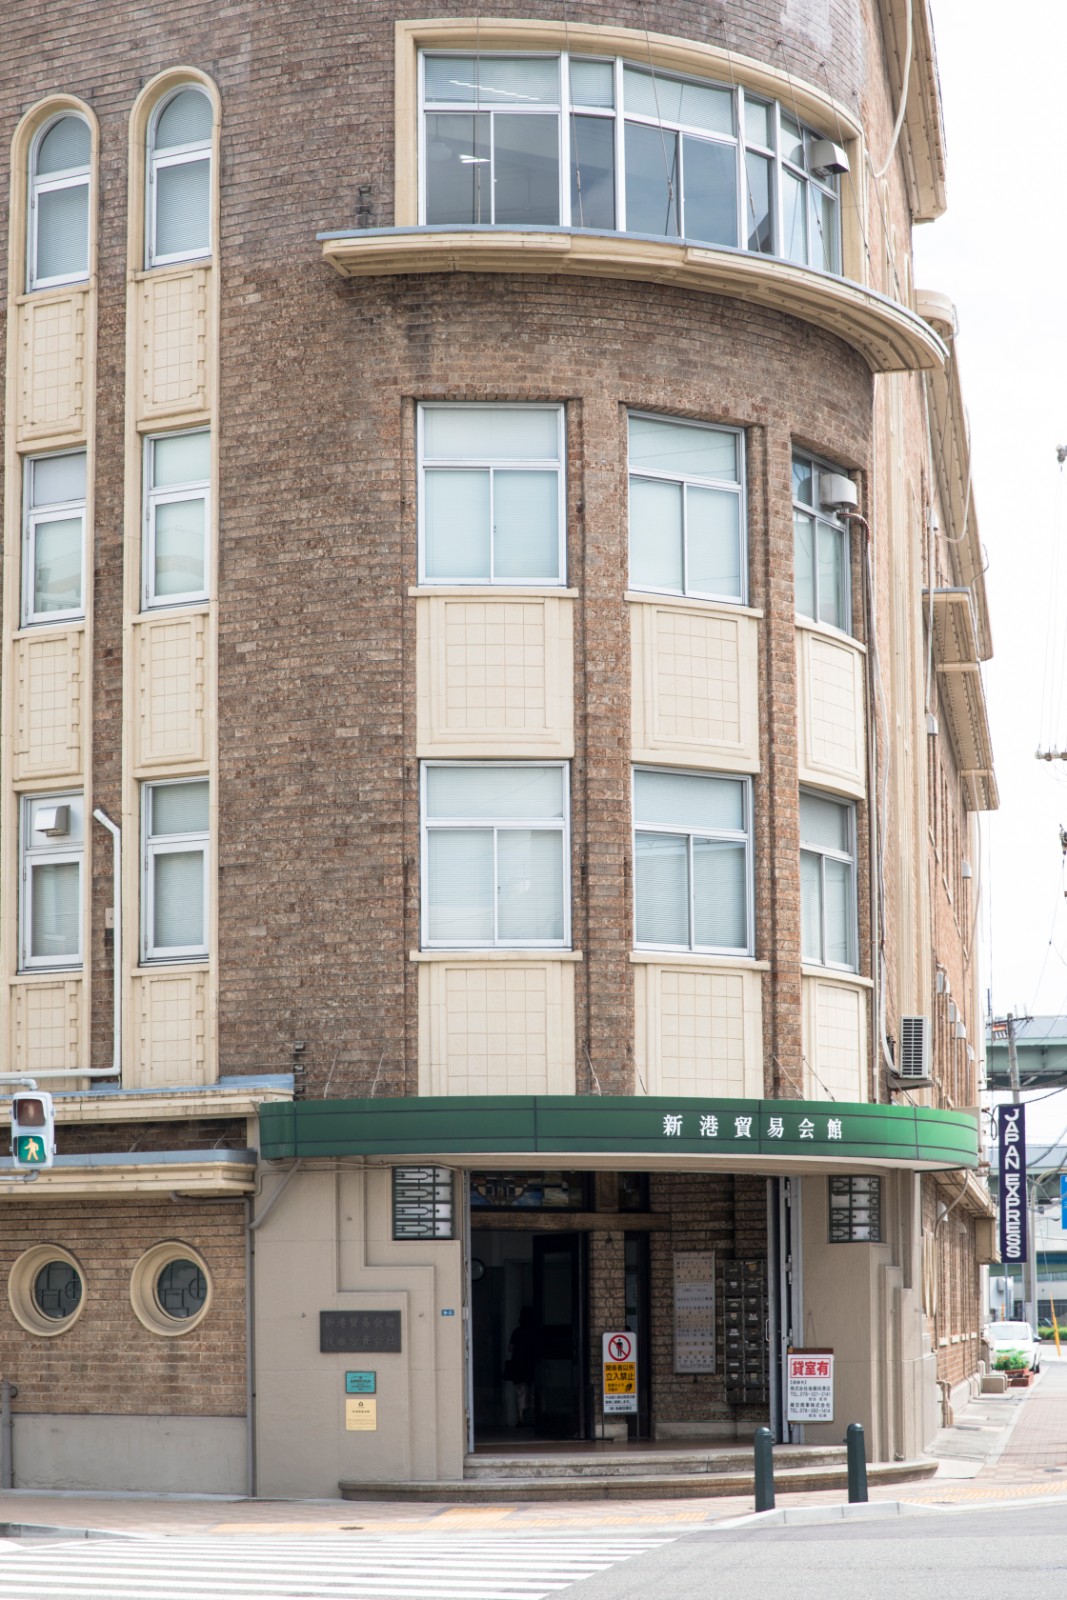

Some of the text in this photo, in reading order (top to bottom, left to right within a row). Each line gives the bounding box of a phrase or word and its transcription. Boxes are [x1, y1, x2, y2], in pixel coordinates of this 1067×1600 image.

[662, 1113, 843, 1141] 新港貿易会館
[1004, 1108, 1021, 1259] JAPAN EXPRESS
[605, 1372, 635, 1381] 立入禁止
[792, 1360, 829, 1376] 貸室有
